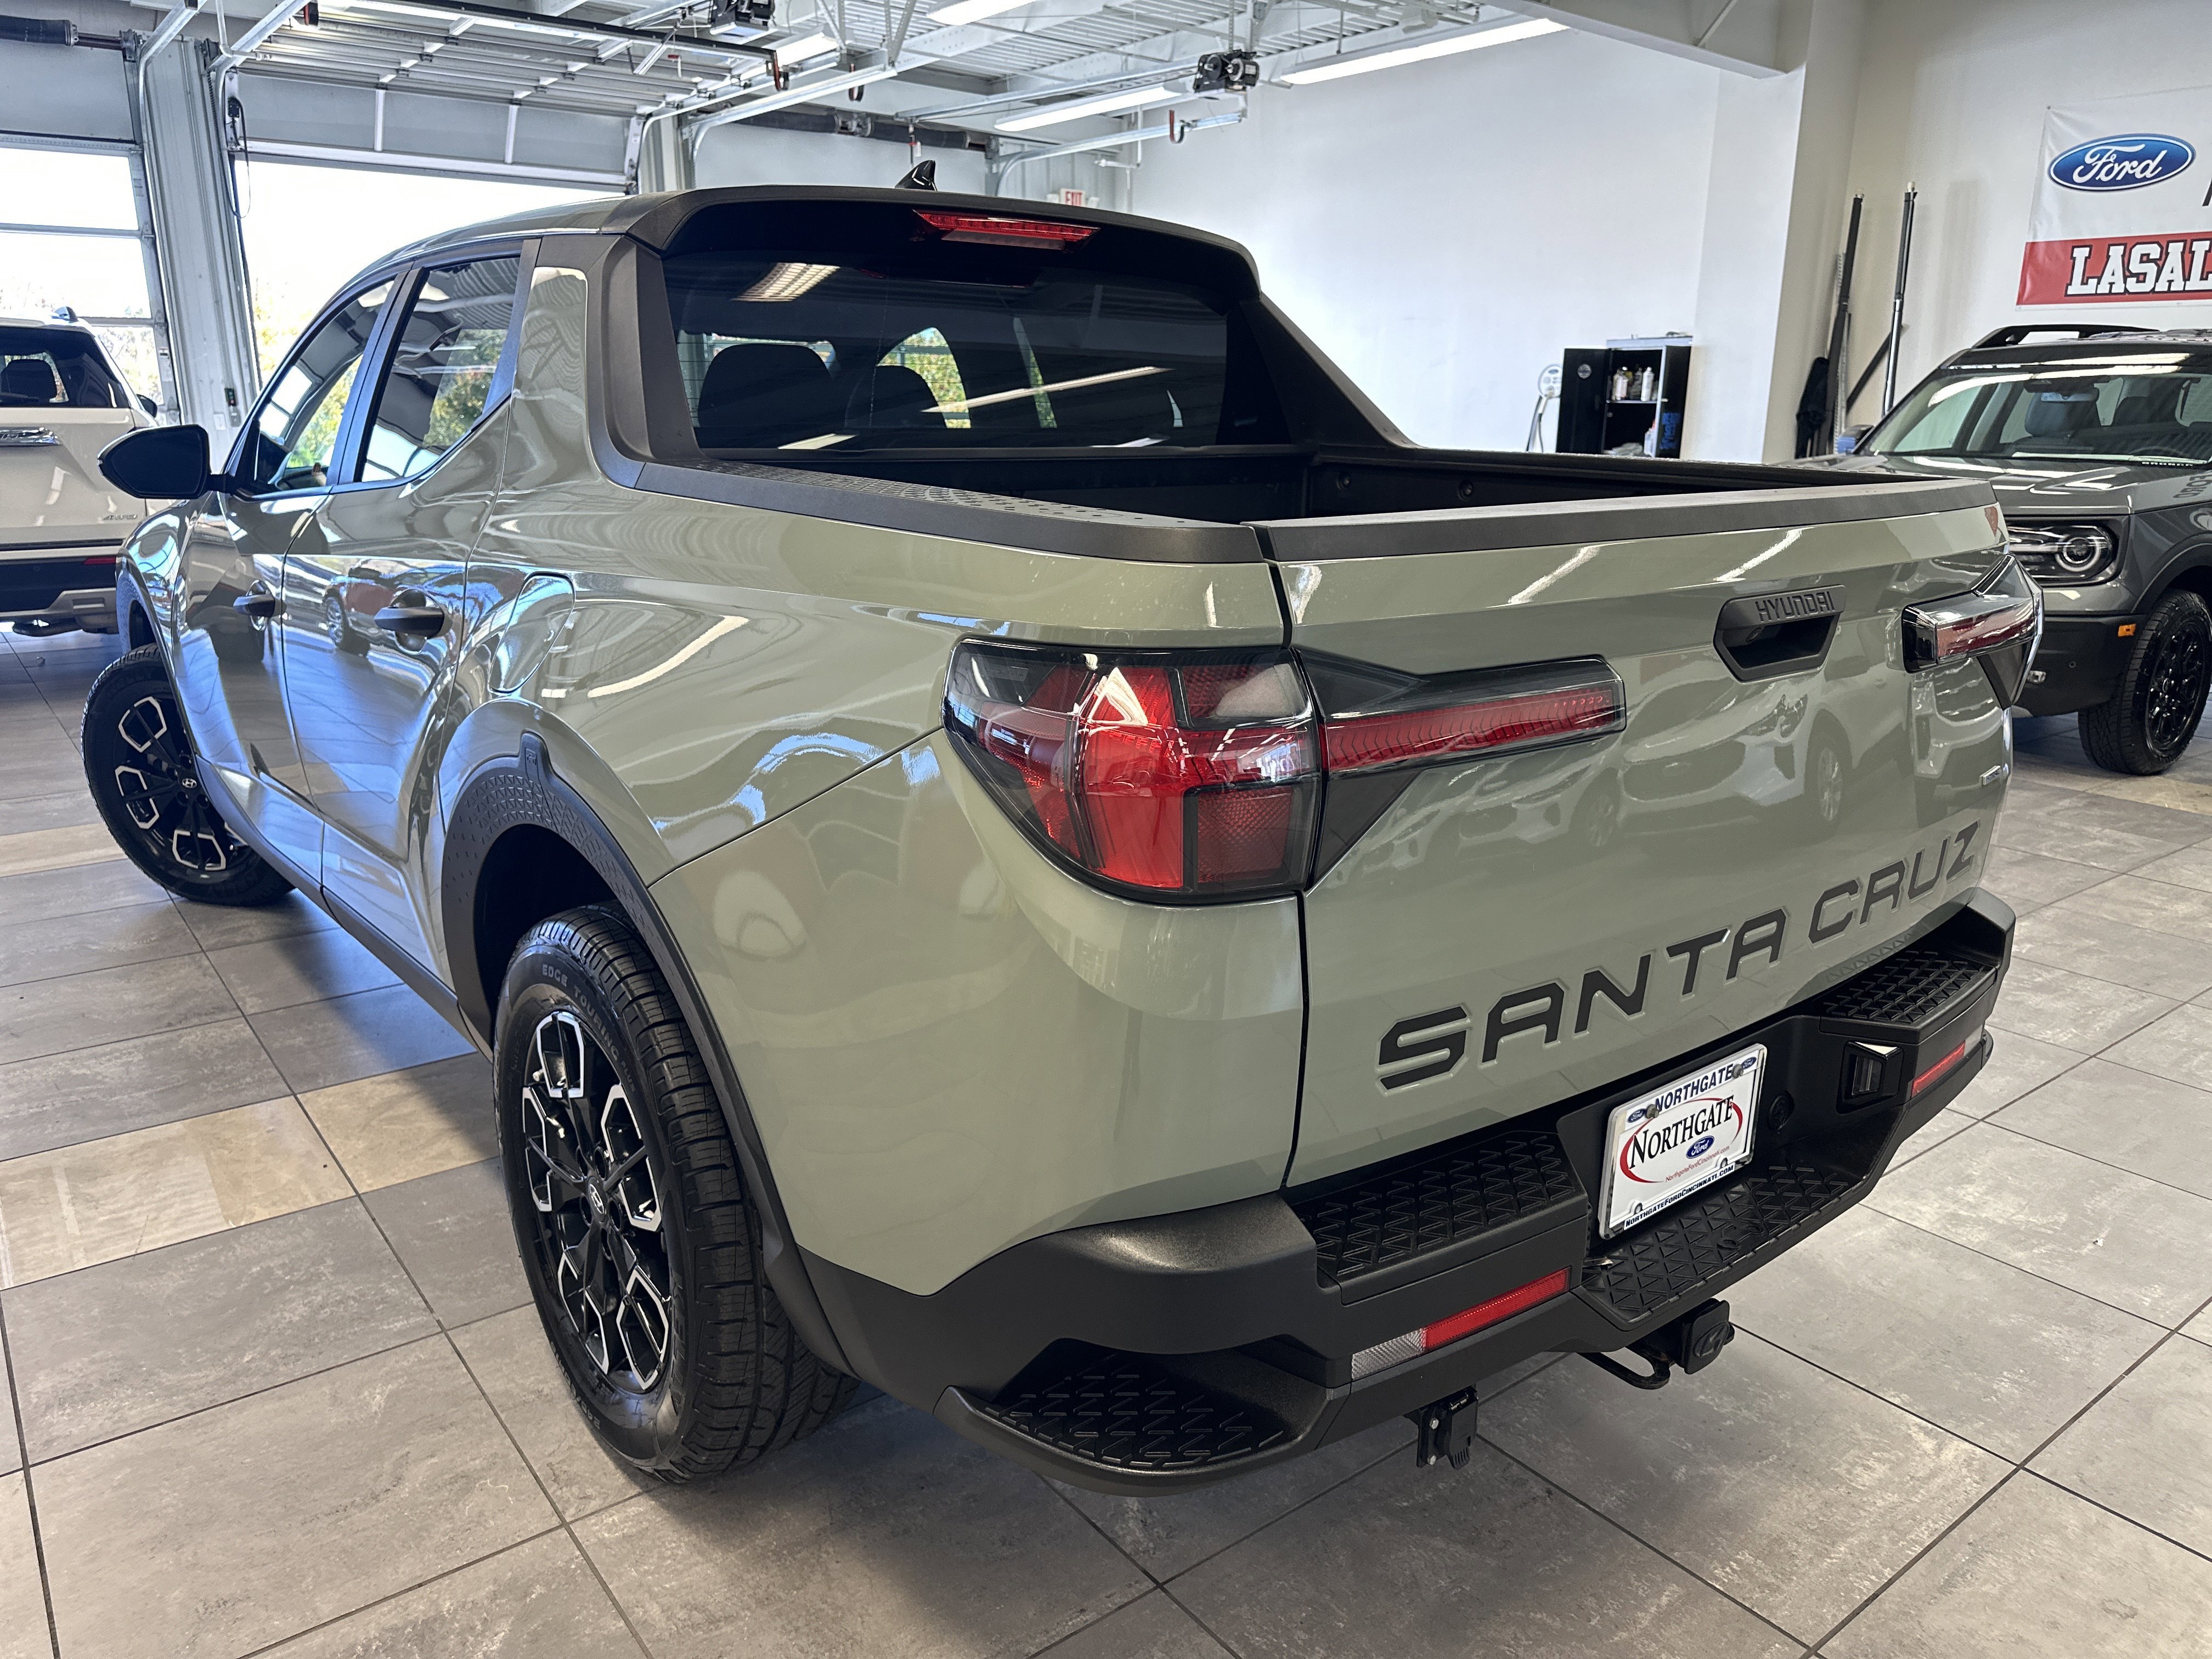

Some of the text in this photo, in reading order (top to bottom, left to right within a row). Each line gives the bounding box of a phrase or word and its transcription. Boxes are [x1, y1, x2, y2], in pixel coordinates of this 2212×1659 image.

[2072, 144, 2168, 183] Ford
[1755, 591, 1835, 623] HYUNDAI
[1378, 821, 1979, 1091] SANTA CRUZ
[542, 964, 568, 987] EDGE
[574, 985, 619, 1061] TOURING
[1655, 1063, 1734, 1113] NORTHGATE
[1629, 1094, 1734, 1170] NORTHGATE
